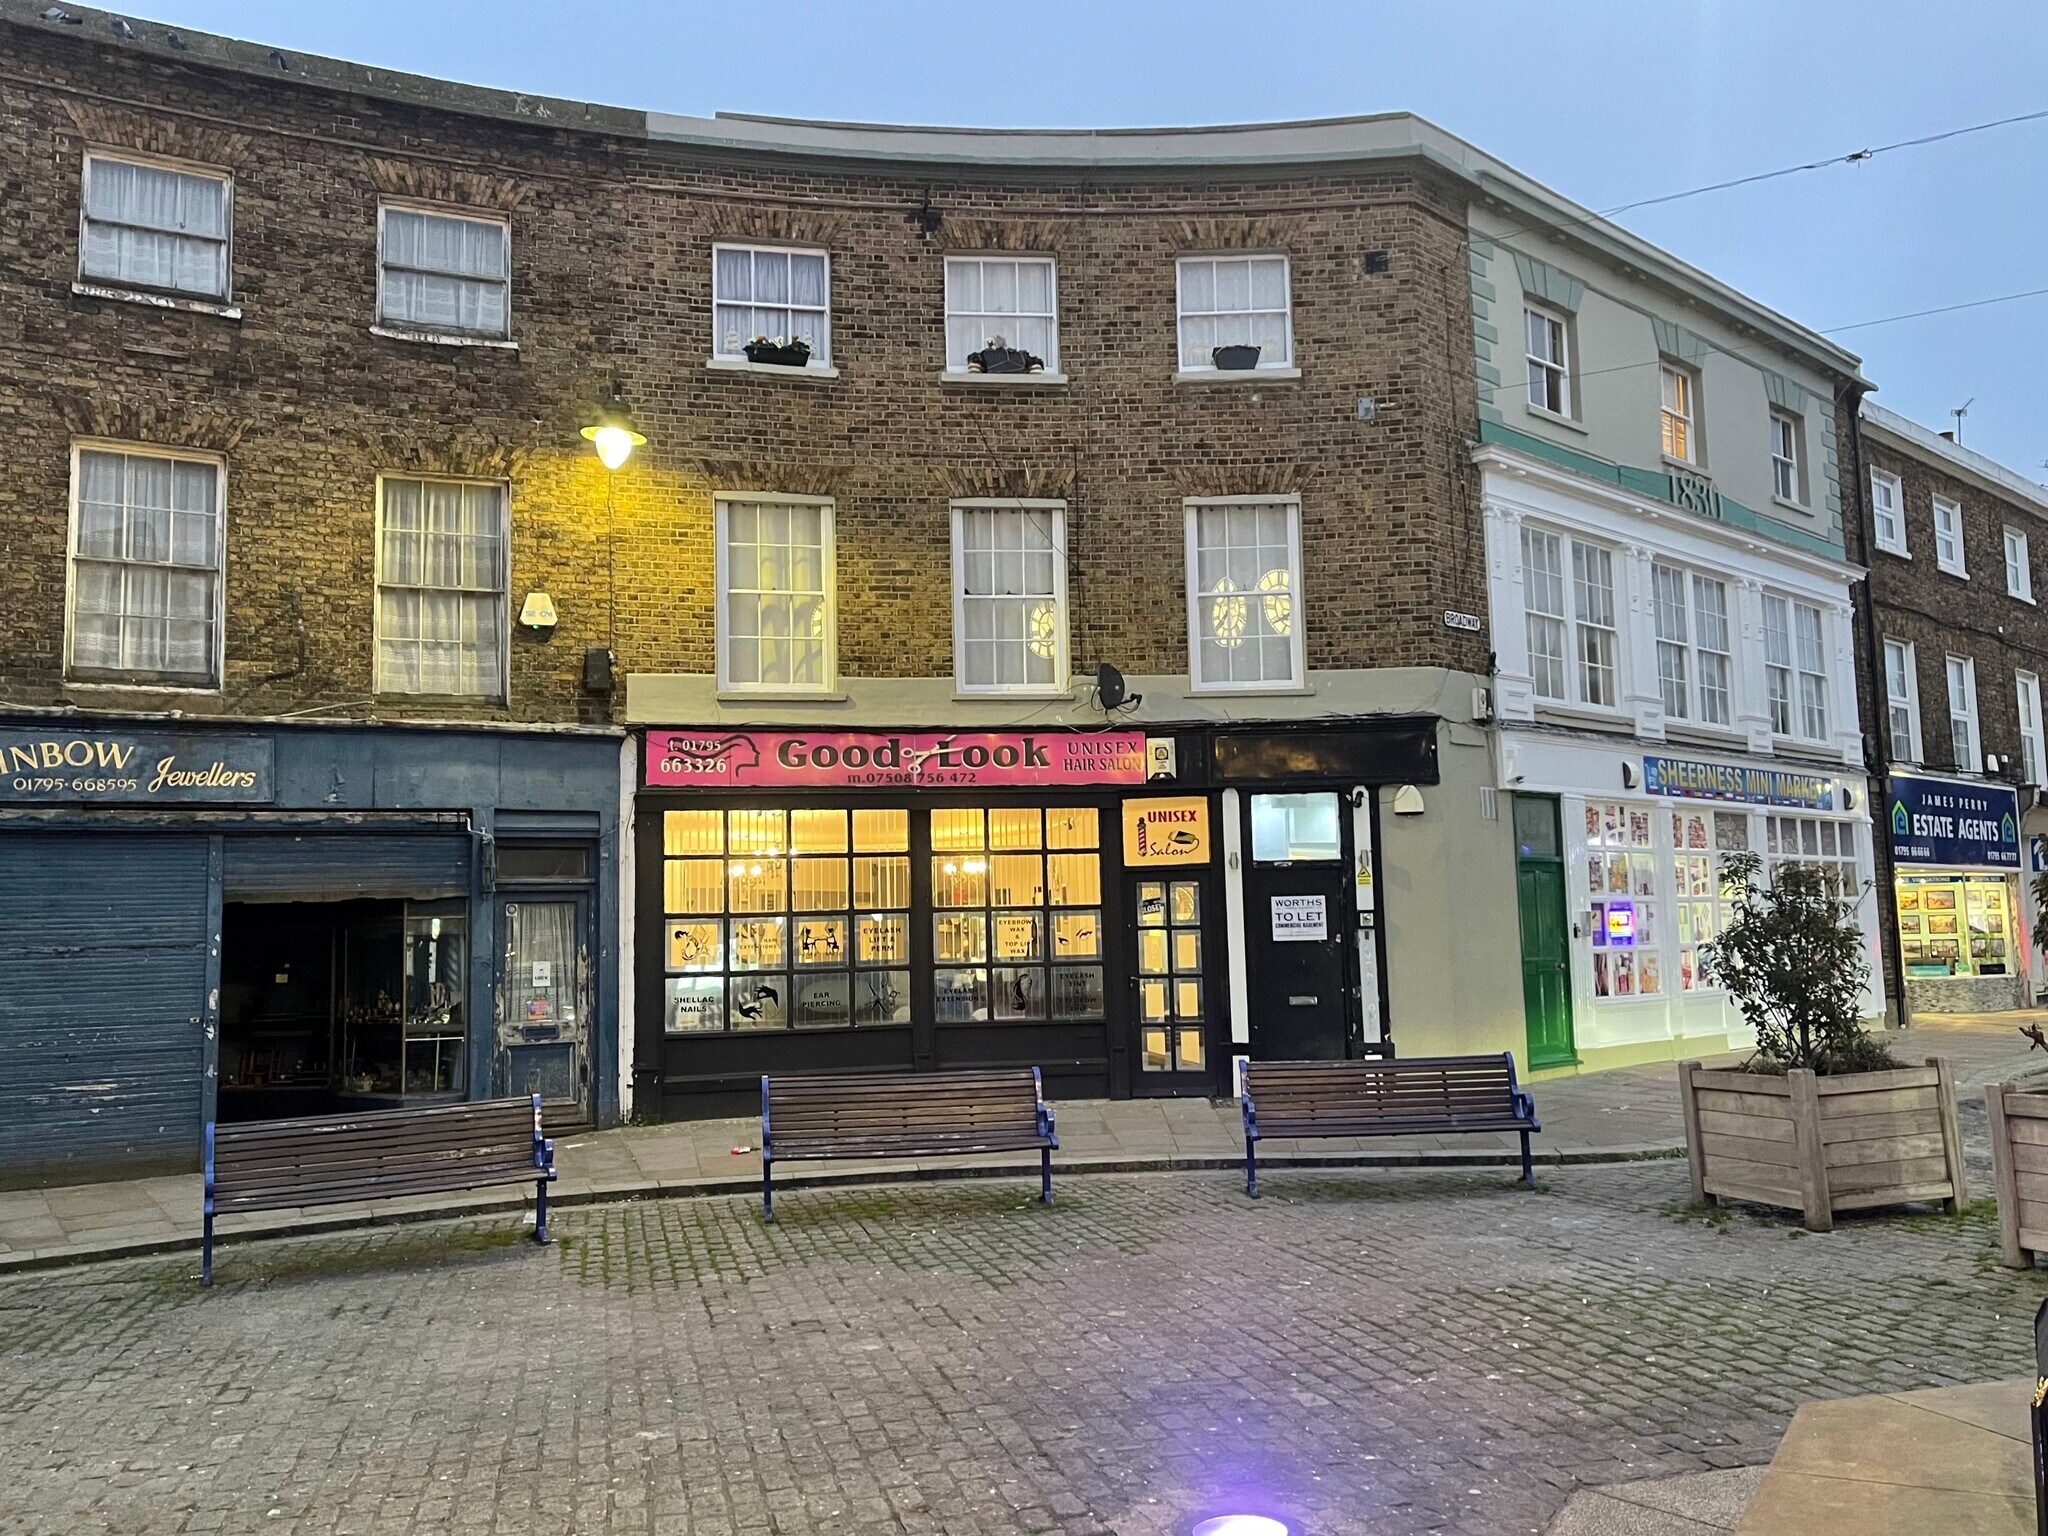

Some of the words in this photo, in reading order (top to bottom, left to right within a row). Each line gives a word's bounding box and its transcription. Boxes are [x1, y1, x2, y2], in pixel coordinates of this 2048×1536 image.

[1669, 466, 1723, 520] 1830
[1445, 612, 1479, 629] BROADWAY
[682, 740, 721, 751] 01795
[1067, 742, 1138, 755] UNISEX
[777, 738, 900, 771] Good
[936, 738, 1051, 770] Look
[660, 758, 727, 774] 663326
[1064, 758, 1095, 771] HAIR
[1099, 756, 1142, 771] SALON
[148, 756, 256, 792] Jewellers
[917, 773, 944, 783] 756
[949, 773, 976, 783] 472
[1657, 759, 1743, 792] SHEERNESS
[1745, 769, 1774, 796] MINI
[1776, 772, 1823, 801] MARKET
[1922, 793, 1954, 807] JAMES
[1959, 797, 1988, 811] PERRY
[1147, 810, 1198, 823] UNISEX
[1913, 813, 1954, 838] ESTATE
[1958, 817, 1999, 842] AGENTS
[1150, 842, 1188, 857] Salon
[1894, 845, 1910, 856] 01795
[1987, 850, 2000, 861] 01795
[1141, 903, 1161, 914] LOSE
[1275, 898, 1323, 907] WORTHS
[1275, 912, 1293, 921] TO
[1297, 911, 1323, 921] LET
[863, 926, 901, 934] EYELASH
[802, 1000, 841, 1008] PIERCING
